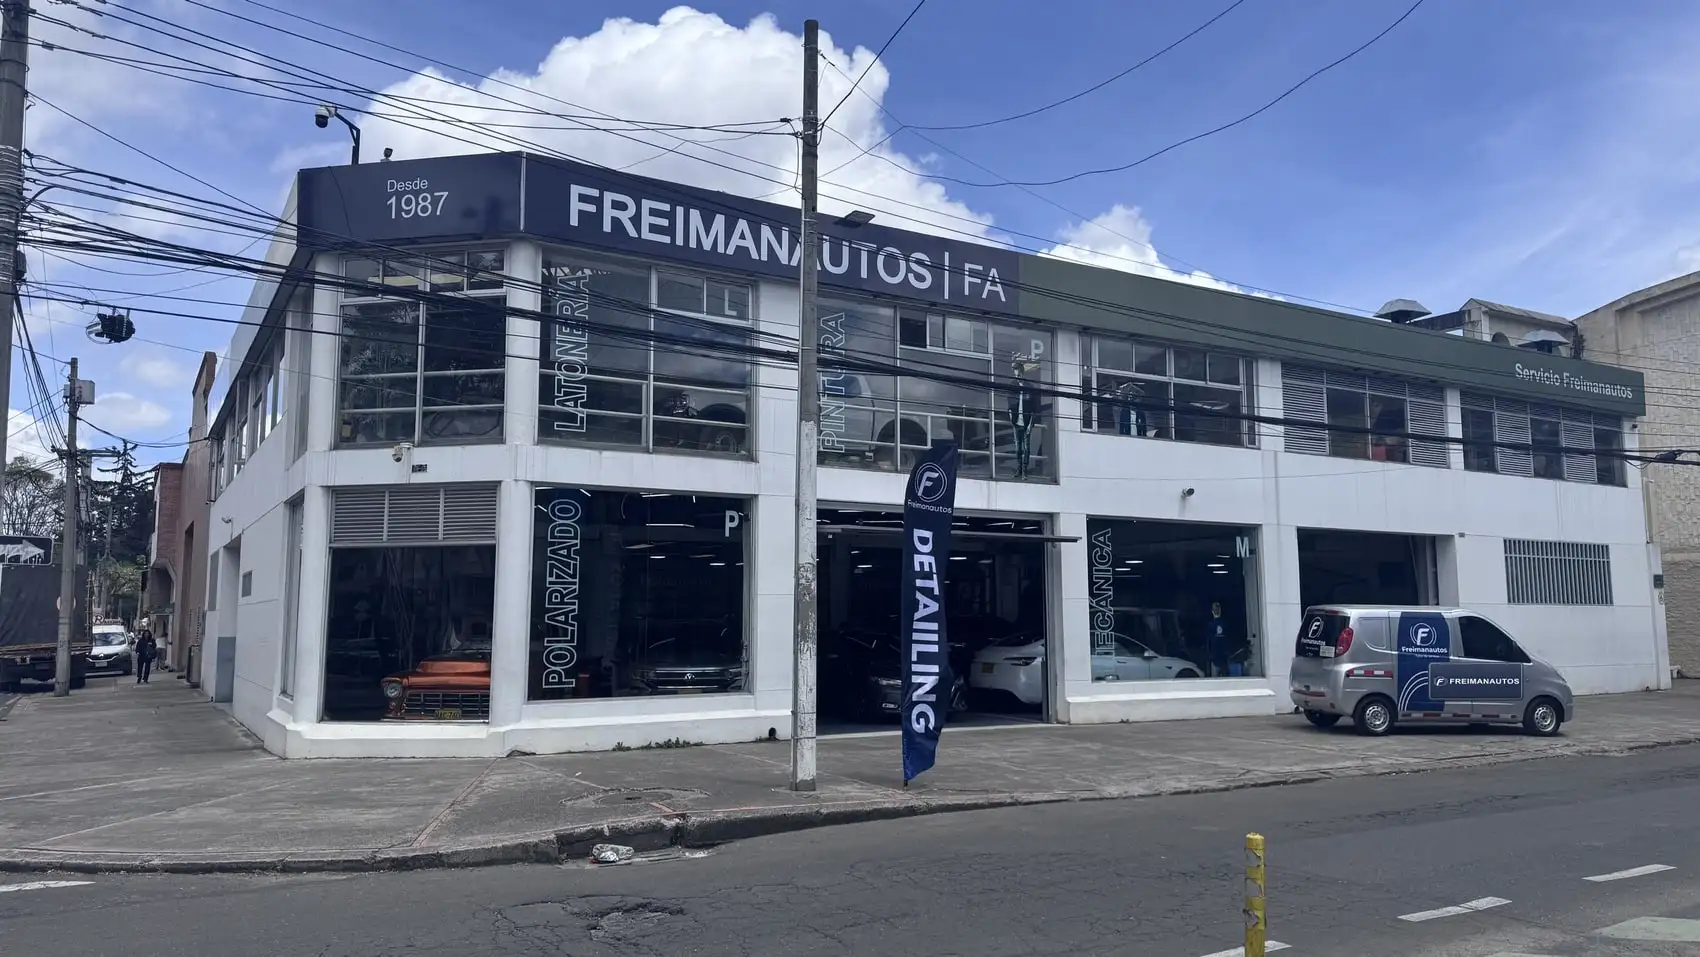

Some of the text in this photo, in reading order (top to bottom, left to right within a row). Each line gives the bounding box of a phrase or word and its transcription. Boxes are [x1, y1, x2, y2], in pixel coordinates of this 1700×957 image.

[387, 177, 428, 192] Desde
[387, 192, 449, 219] 1987
[964, 262, 1006, 302] FA
[1515, 363, 1633, 399] Servicio Freimanautos
[907, 499, 952, 513] Freimanautos
[725, 510, 739, 537] P
[1236, 536, 1250, 558] M
[543, 499, 581, 689] POLARIZADO
[1401, 646, 1448, 654] Freimanautos
